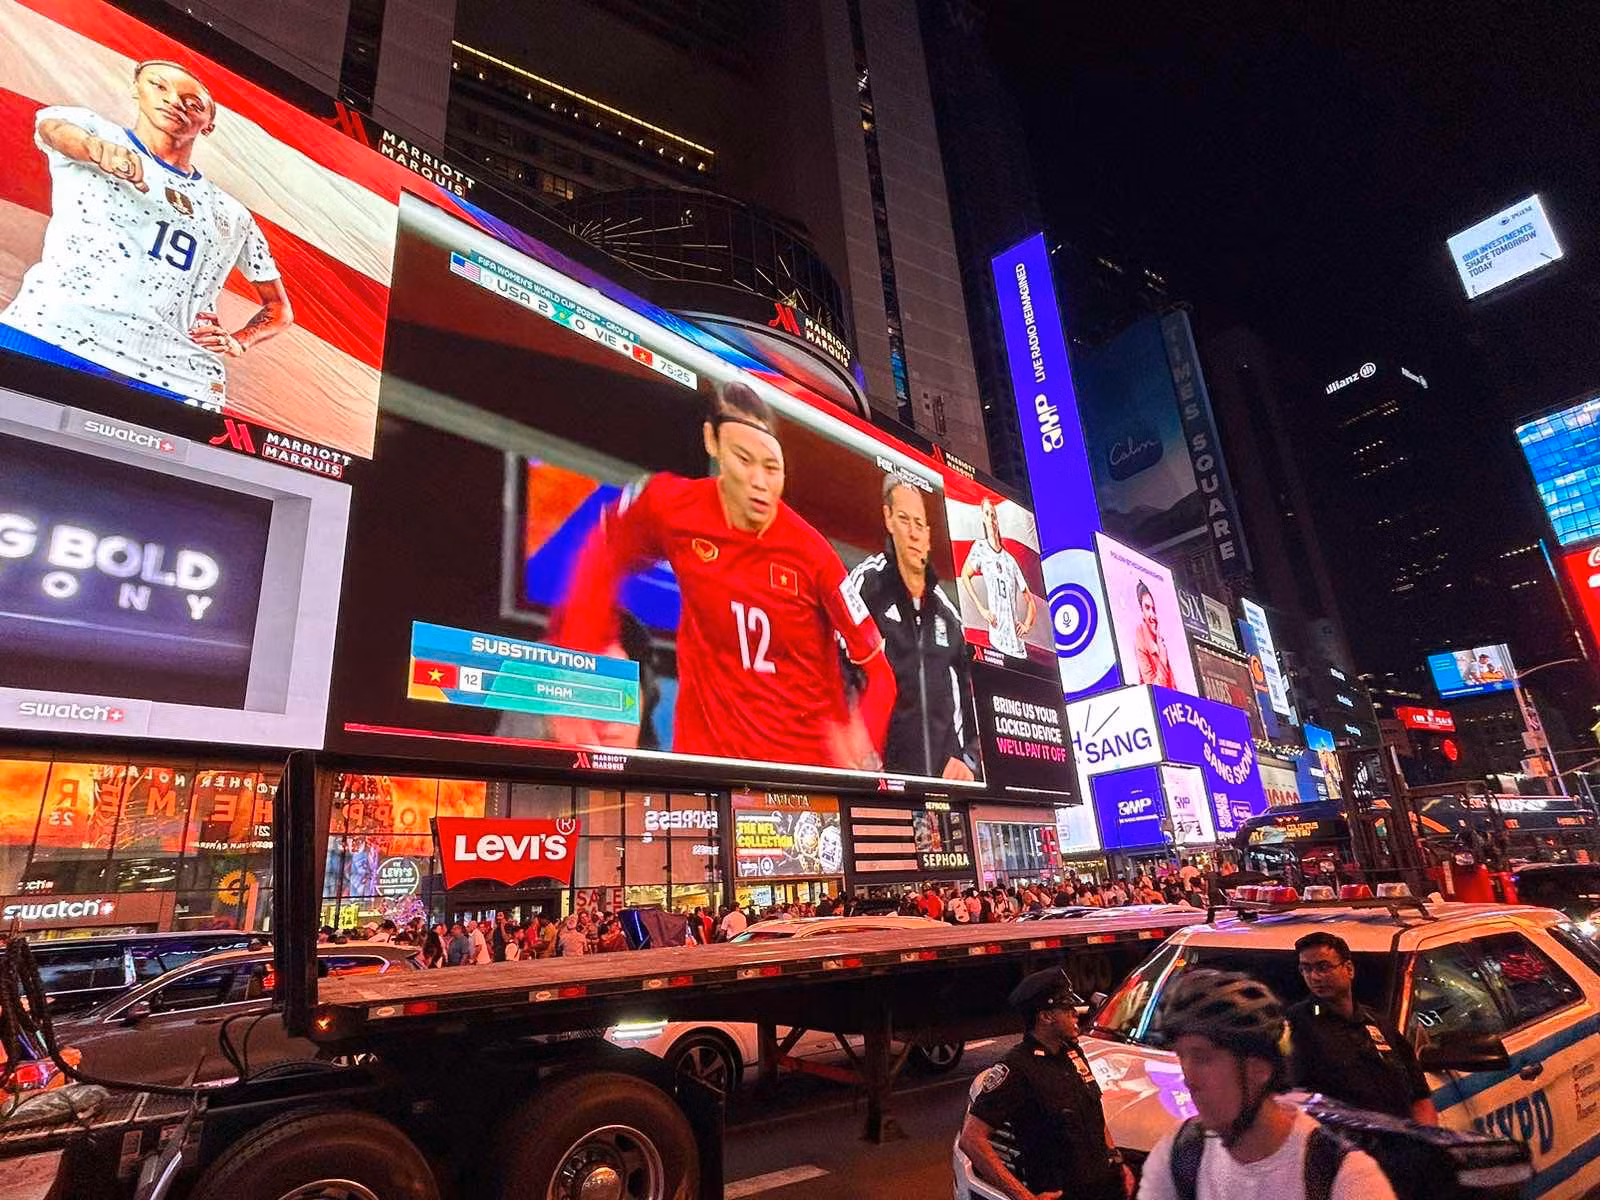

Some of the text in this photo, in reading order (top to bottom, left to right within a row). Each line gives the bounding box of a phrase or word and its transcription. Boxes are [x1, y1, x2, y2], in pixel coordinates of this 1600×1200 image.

[381, 143, 464, 196] MARQUIS
[383, 130, 475, 189] MARRIOTT
[148, 220, 197, 271] 19
[1465, 230, 1537, 270] SHAPE TOMORROW
[1480, 222, 1534, 253] INVESTMENTS
[1468, 261, 1494, 277] TODAY
[478, 256, 496, 272] FIFA
[498, 265, 533, 290] WOMEN'S
[533, 284, 560, 303] WORLD
[561, 299, 575, 311] CUP
[606, 320, 629, 338] GROUP
[498, 279, 530, 304] USA
[538, 300, 548, 313] 2
[595, 327, 617, 346] VIE
[660, 360, 690, 383] 75:25
[804, 317, 850, 359] MARRIOTT
[1015, 263, 1046, 383] LIVE RADIO REIMAGINED
[806, 330, 849, 368] MARQUIS
[84, 420, 161, 450] swatch
[267, 432, 351, 467] MARRIOTT
[265, 445, 340, 476] MARQUIS
[1192, 434, 1236, 560] SQUARE
[48, 524, 219, 590] BOLD
[1178, 589, 1206, 624] SIX
[471, 636, 596, 670] SUBSTITUTION
[731, 600, 776, 674] 12
[463, 674, 478, 686] 12
[536, 684, 572, 698] PHAM
[19, 702, 108, 721] swatch
[992, 695, 1058, 724] BRING US YOUR
[1162, 703, 1216, 747] THE ZACH
[995, 716, 1062, 743] LOCKED DEVICE
[1085, 727, 1152, 764] SANG
[996, 737, 1066, 762] WE'LL PAY IT OFF
[1203, 742, 1234, 784] SANG
[1233, 741, 1252, 784] SHOW
[765, 793, 809, 808] INVICTA
[925, 802, 950, 810] SEPHORA
[737, 835, 793, 848] COLLECTION
[923, 853, 969, 867] SEPHORA
[3, 899, 101, 920] swatch
[577, 889, 622, 906] SAE
